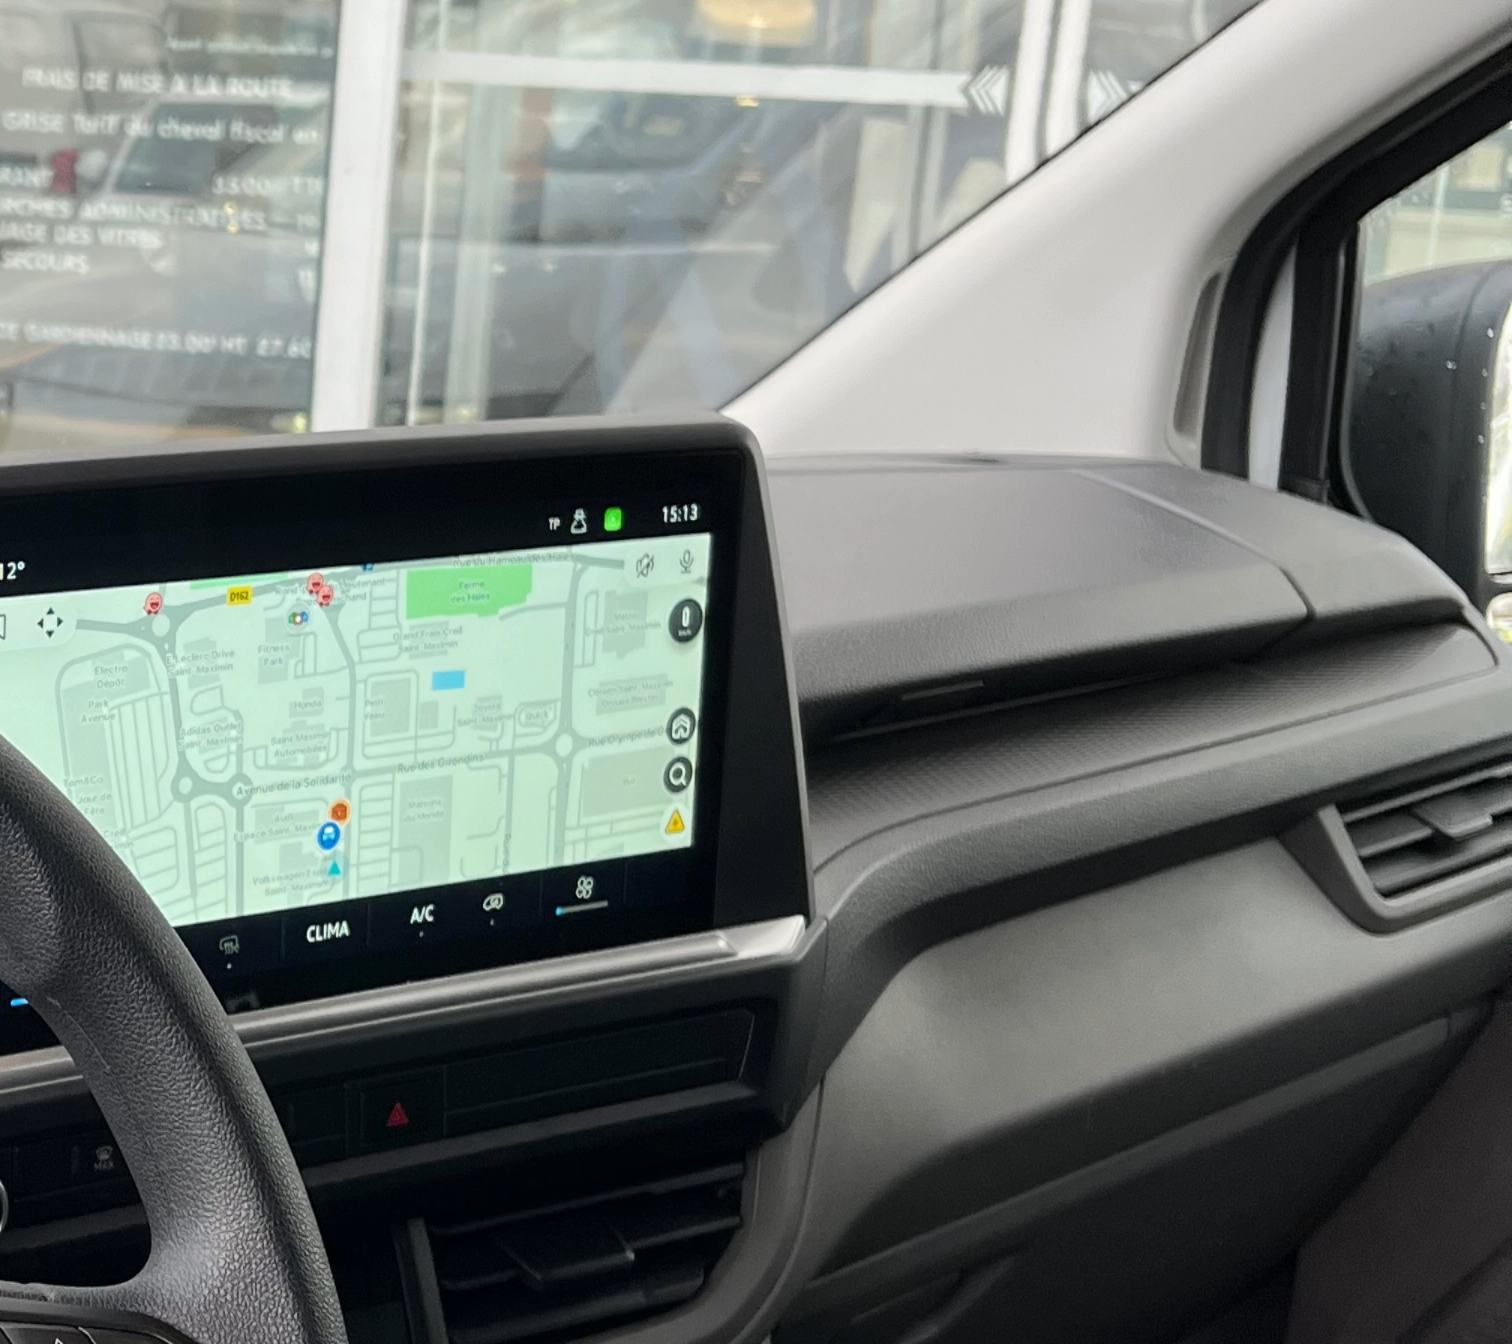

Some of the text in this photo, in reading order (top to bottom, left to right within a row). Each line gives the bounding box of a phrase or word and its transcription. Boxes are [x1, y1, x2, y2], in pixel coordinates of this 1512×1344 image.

[662, 504, 699, 523] 15:13
[458, 580, 486, 590] Ferme
[681, 606, 690, 628] 0
[258, 643, 289, 654] Fitness
[264, 656, 283, 666] Park
[88, 699, 109, 709] Park
[294, 698, 322, 709] Honda
[80, 712, 116, 723] Avenue
[273, 743, 328, 758] Automobiles
[397, 762, 419, 774] Rue
[436, 752, 484, 768] Girondins
[235, 783, 275, 797] Avenue
[274, 813, 294, 823] Audi
[409, 904, 435, 924] A/C
[306, 920, 350, 943] CLIMA
